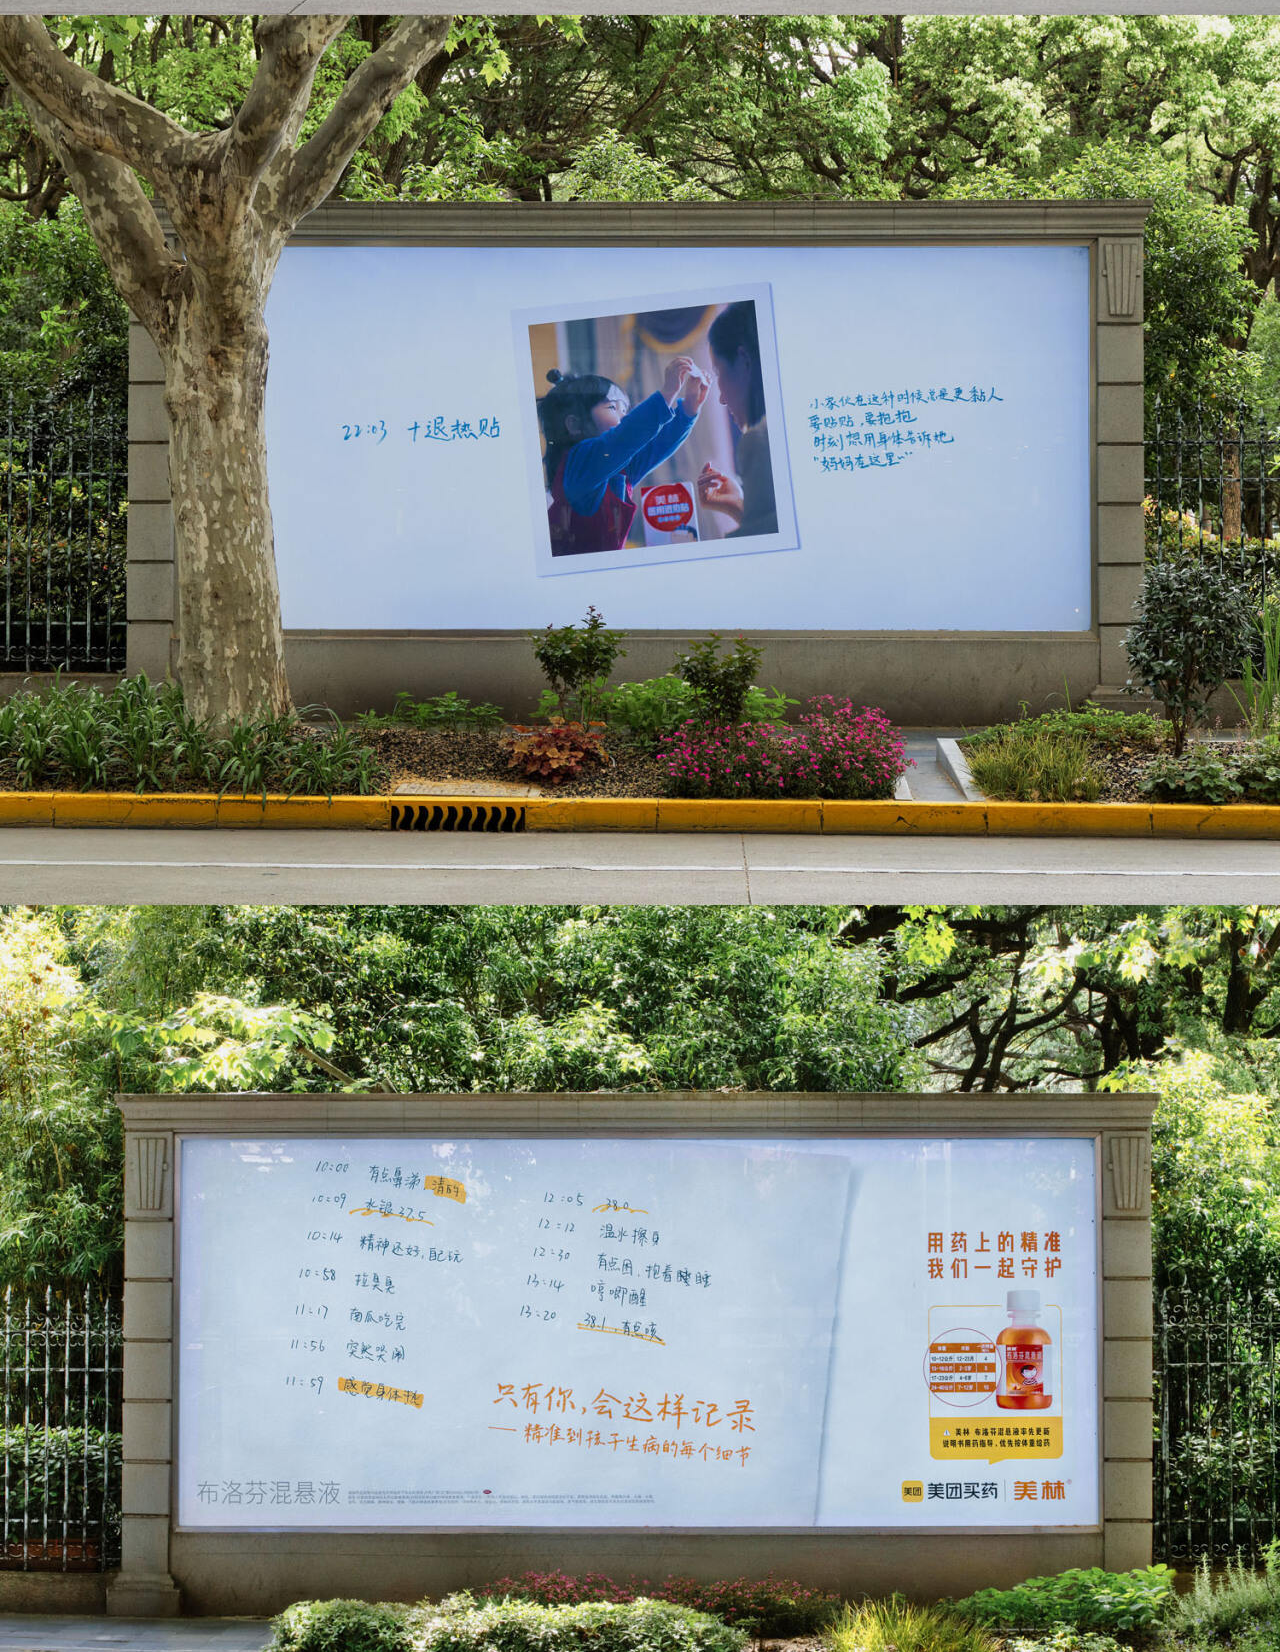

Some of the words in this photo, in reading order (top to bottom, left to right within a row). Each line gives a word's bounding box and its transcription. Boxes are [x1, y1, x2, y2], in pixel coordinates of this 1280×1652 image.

[342, 419, 387, 445] 22:03
[315, 1160, 349, 1173] 10:00
[312, 1192, 347, 1209] 10:09
[543, 1191, 585, 1206] 12:05
[538, 1217, 575, 1233] 12:12
[307, 1230, 343, 1242] 10:14
[927, 1231, 1062, 1254] 用药上的精准
[533, 1246, 570, 1261] 12:30
[927, 1256, 1063, 1279] 我们一起守护
[299, 1268, 336, 1282] 10:58
[354, 1272, 396, 1295] 拉臭臭
[527, 1273, 565, 1292] 13:14
[591, 1279, 648, 1307] 哼唧醒
[295, 1304, 329, 1319] 11:17
[349, 1306, 407, 1331] 南瓜吃完
[519, 1304, 557, 1321] 13:20
[290, 1339, 326, 1352] 11:56
[346, 1339, 406, 1363] 突然哭闹
[285, 1375, 324, 1395] 11:59
[492, 1382, 756, 1434] 只有你，会这样记录
[197, 1480, 341, 1506] 布洛芬混悬液
[927, 1481, 998, 1500] 美团买药
[1013, 1480, 1066, 1500] 美林
